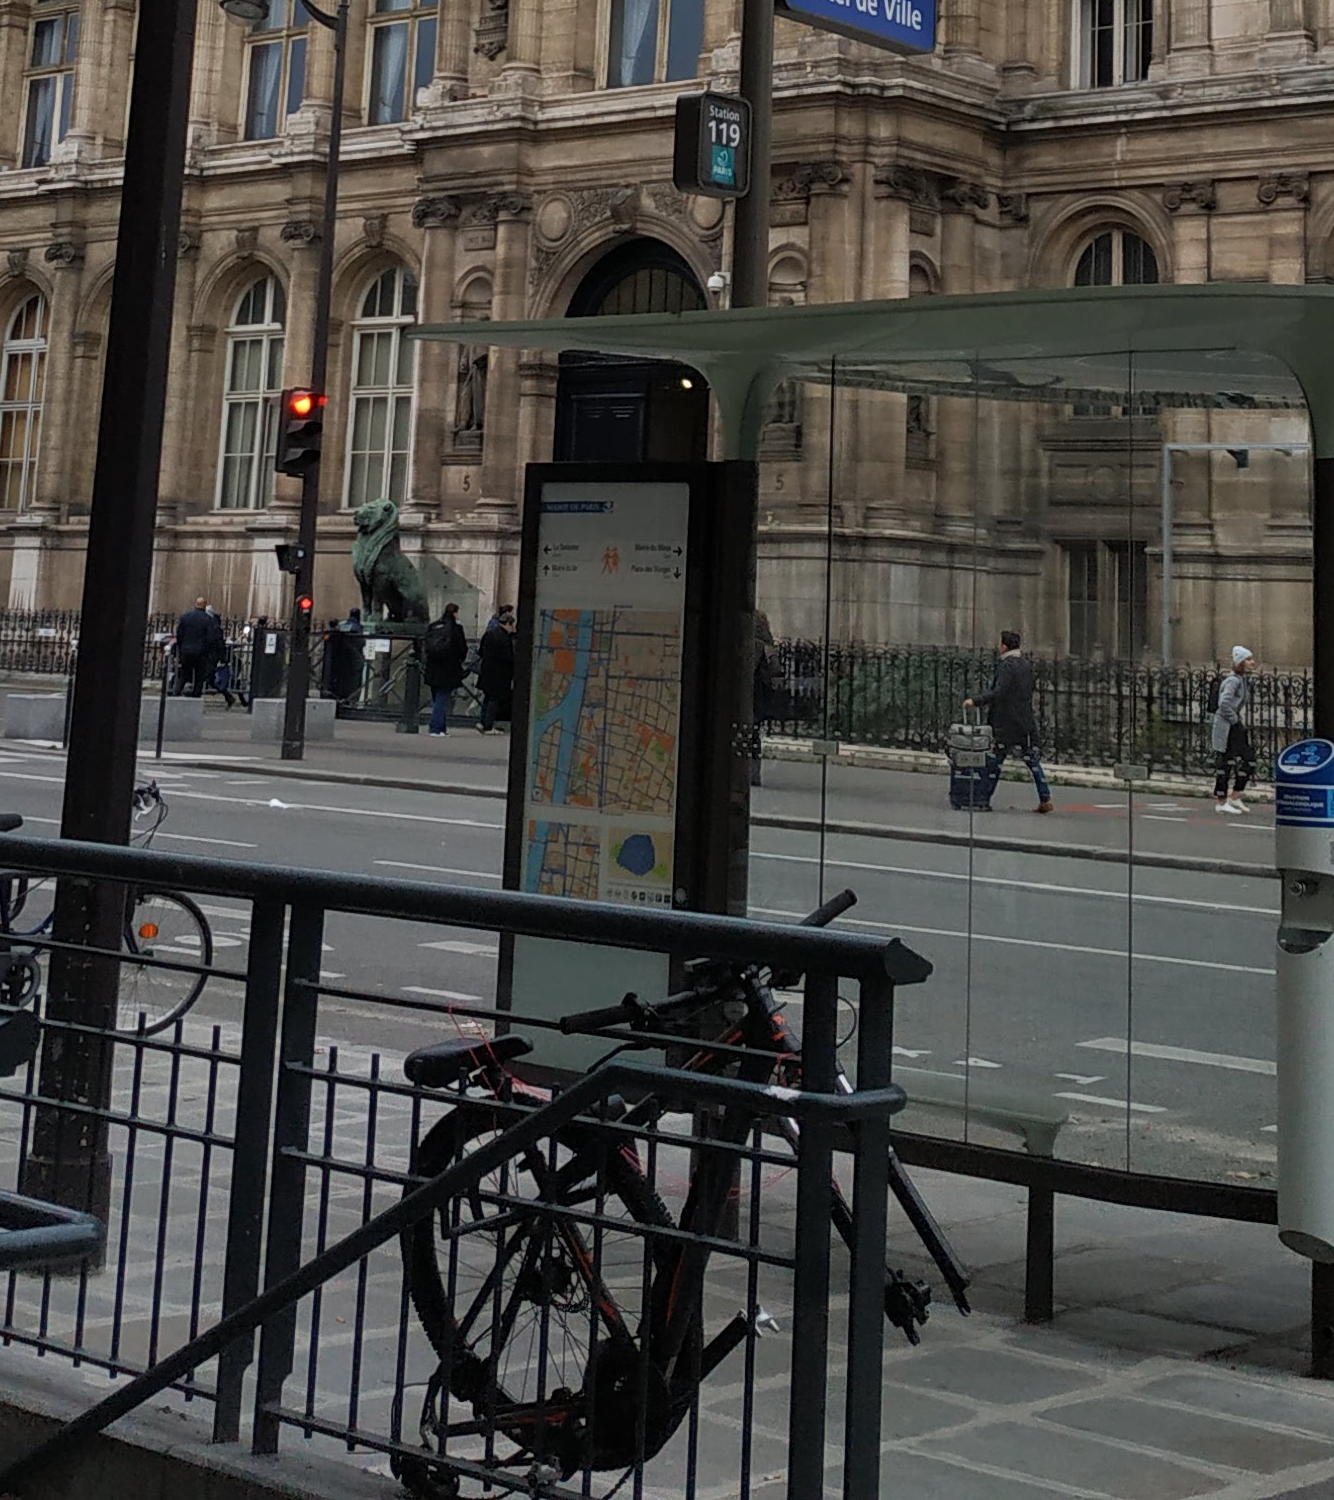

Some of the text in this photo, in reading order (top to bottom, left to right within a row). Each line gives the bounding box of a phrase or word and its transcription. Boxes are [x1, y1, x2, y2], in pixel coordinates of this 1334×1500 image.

[709, 104, 740, 122] Station
[708, 120, 740, 148] 119
[462, 474, 471, 493] 5
[774, 473, 785, 491] 5
